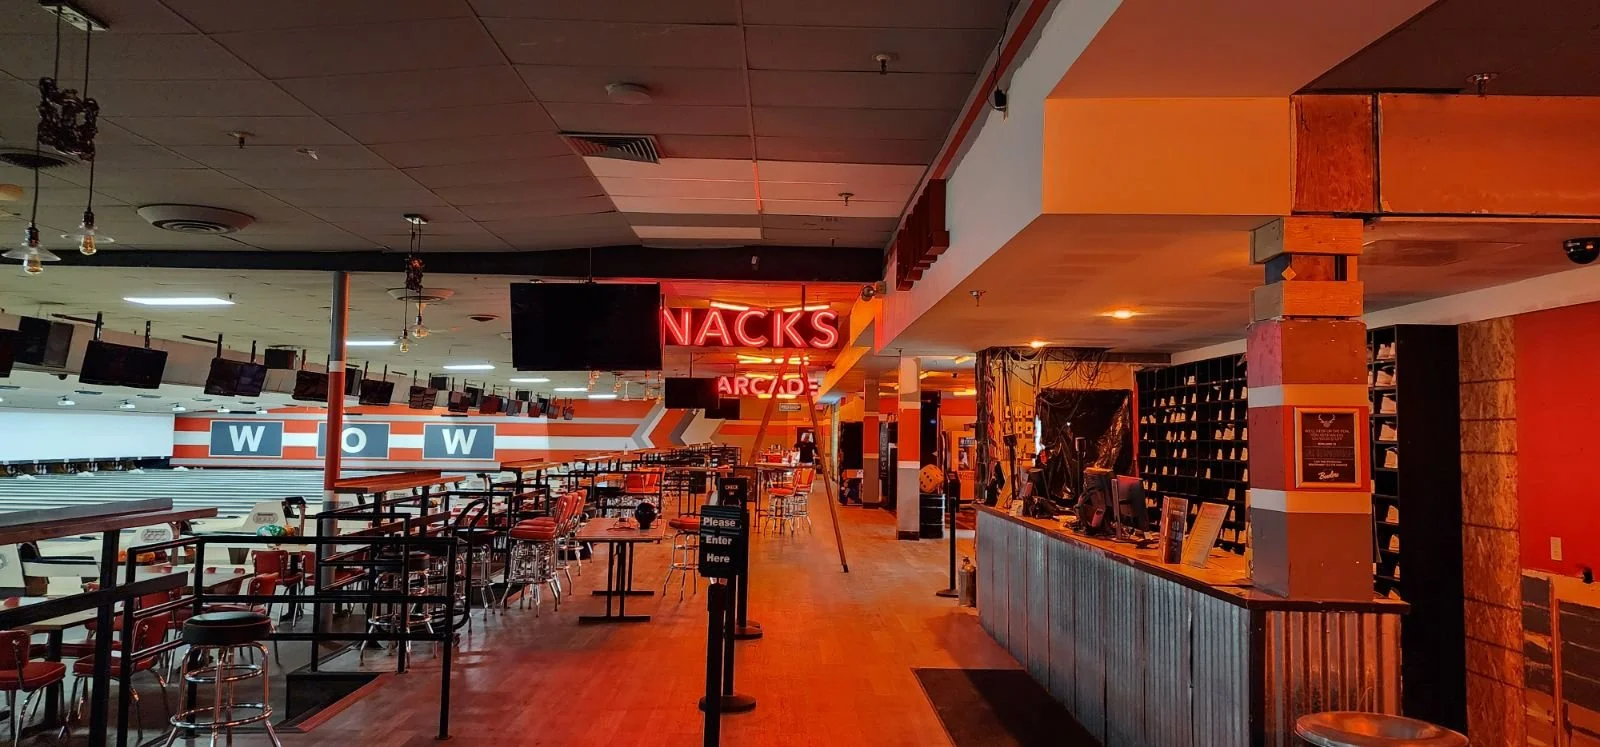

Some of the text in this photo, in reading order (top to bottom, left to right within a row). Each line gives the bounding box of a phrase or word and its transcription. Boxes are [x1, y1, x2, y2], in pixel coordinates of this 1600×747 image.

[229, 425, 477, 455] W O W
[703, 517, 736, 527] Please
[705, 535, 733, 545] Enter
[706, 553, 731, 563] Here
